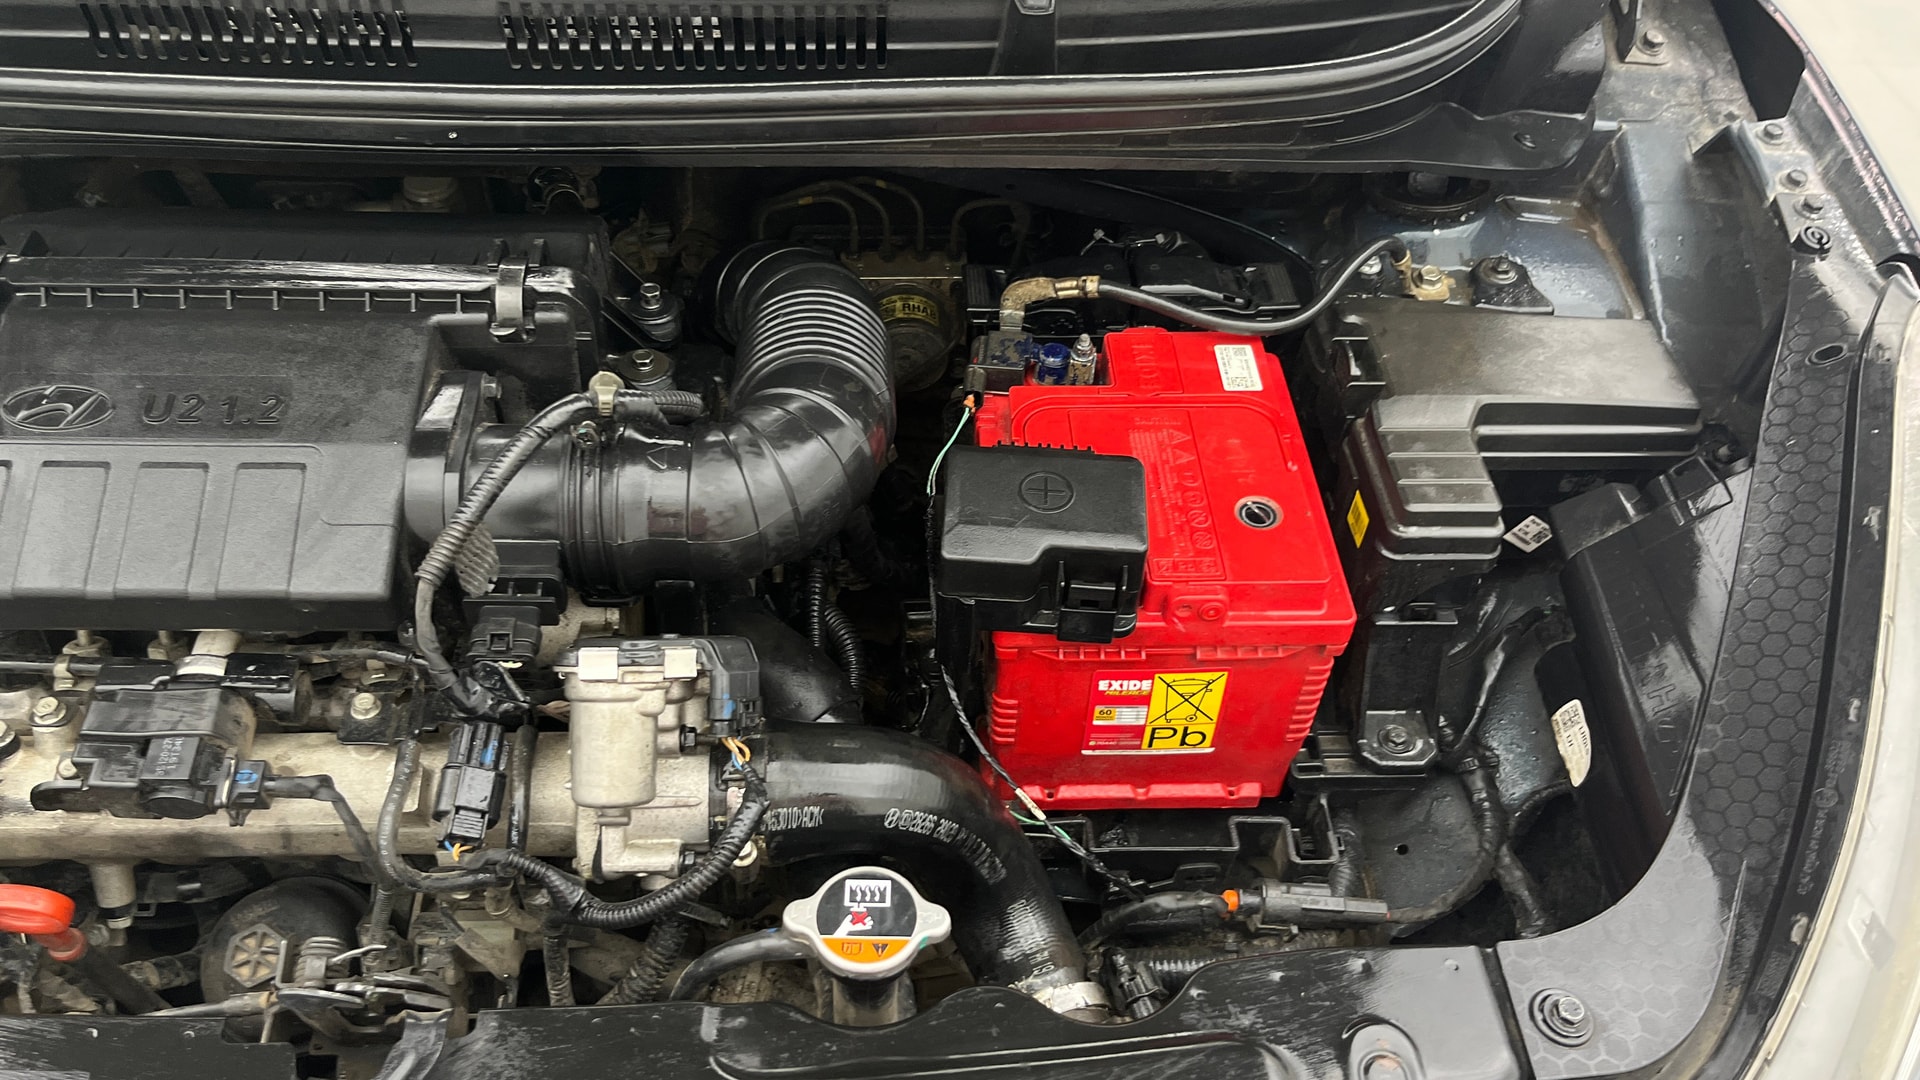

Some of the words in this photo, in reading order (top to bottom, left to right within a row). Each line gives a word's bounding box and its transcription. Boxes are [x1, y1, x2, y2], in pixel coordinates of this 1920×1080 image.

[142, 393, 205, 425] U2
[221, 394, 285, 425] 1.2
[1098, 679, 1152, 691] EXIDE
[1147, 726, 1207, 748] Pb
